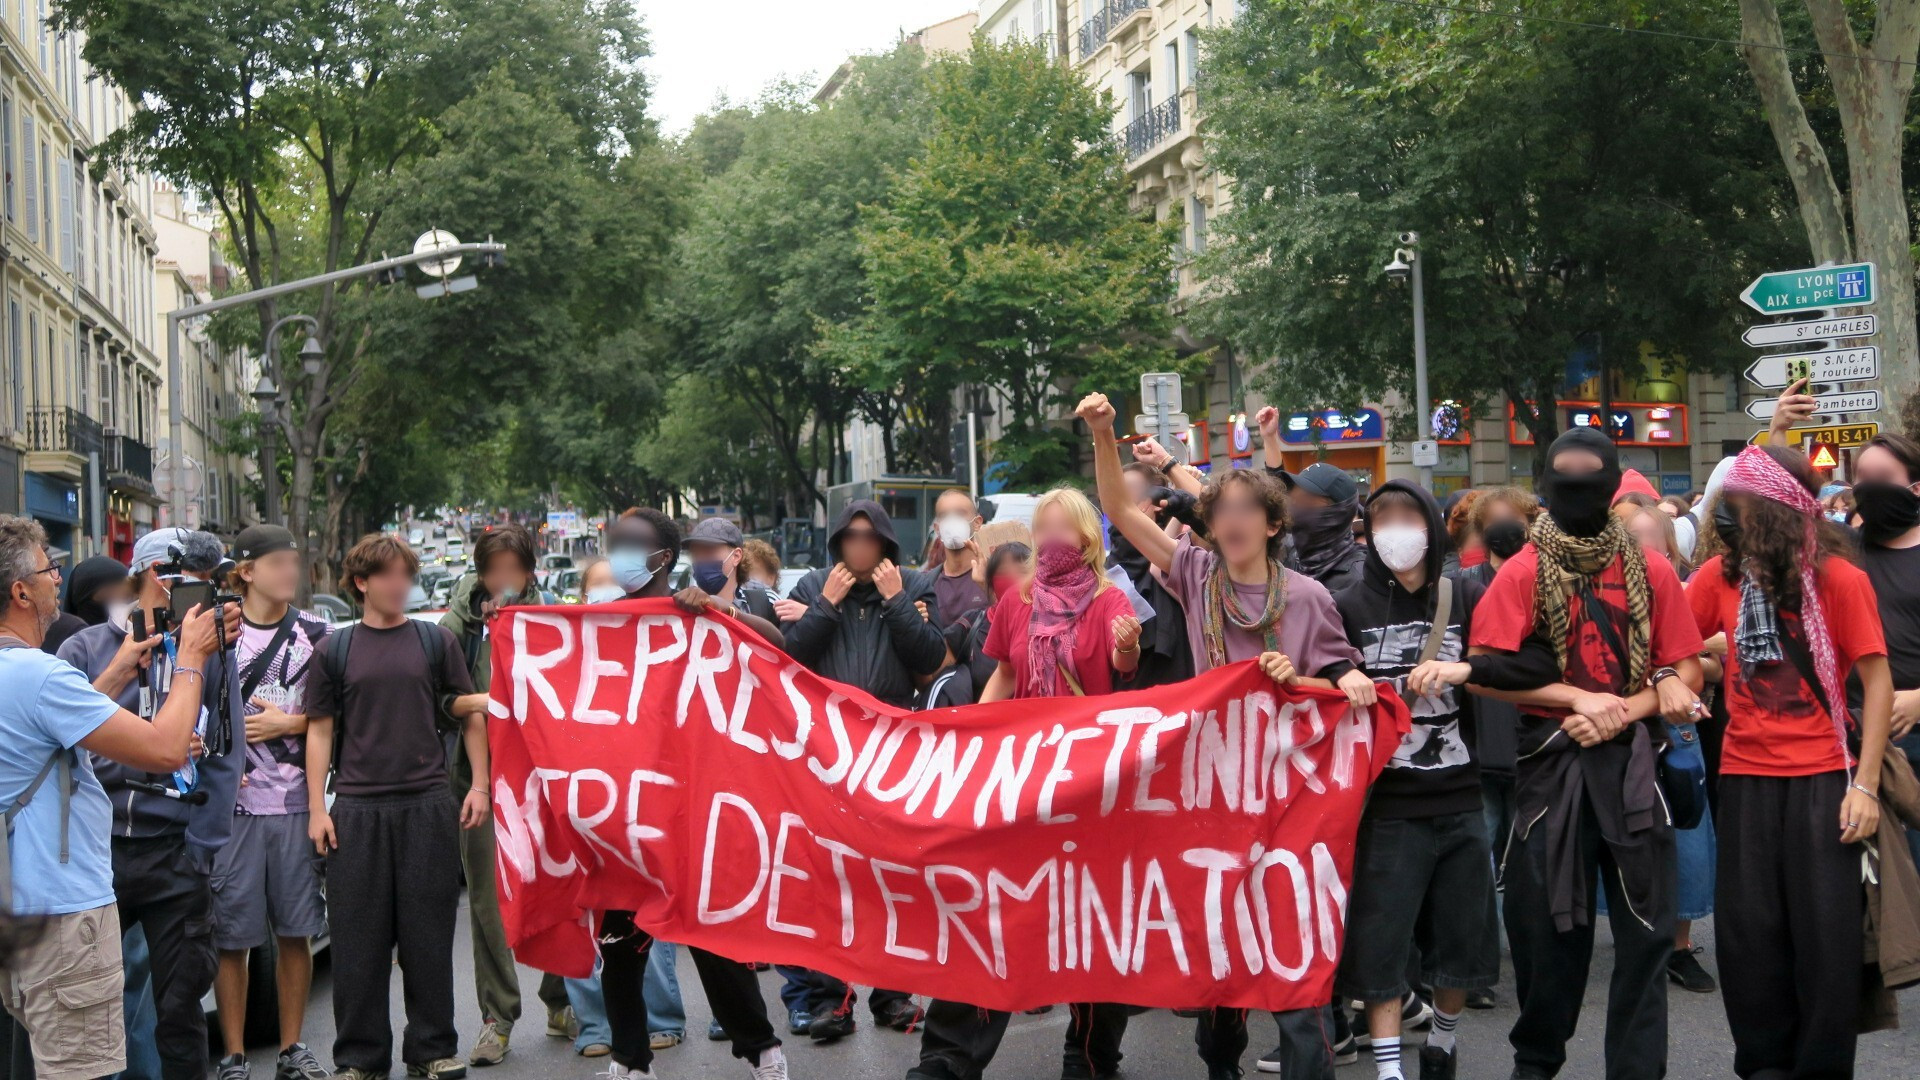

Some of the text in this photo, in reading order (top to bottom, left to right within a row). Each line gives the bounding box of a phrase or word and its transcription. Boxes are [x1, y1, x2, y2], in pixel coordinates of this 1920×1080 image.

[1798, 274, 1834, 289] LYON
[1767, 294, 1789, 307] AIX
[1796, 296, 1808, 305] EN
[1815, 320, 1870, 335] CHARLES
[1824, 353, 1871, 366] S.N.C.F.
[1823, 366, 1871, 378] routière
[1815, 398, 1873, 410] Gambetta
[1574, 413, 1628, 427] EAY
[1815, 428, 1870, 443] 43 S 41
[1663, 478, 1689, 490] Cuisine
[512, 612, 983, 819] REPRESSION
